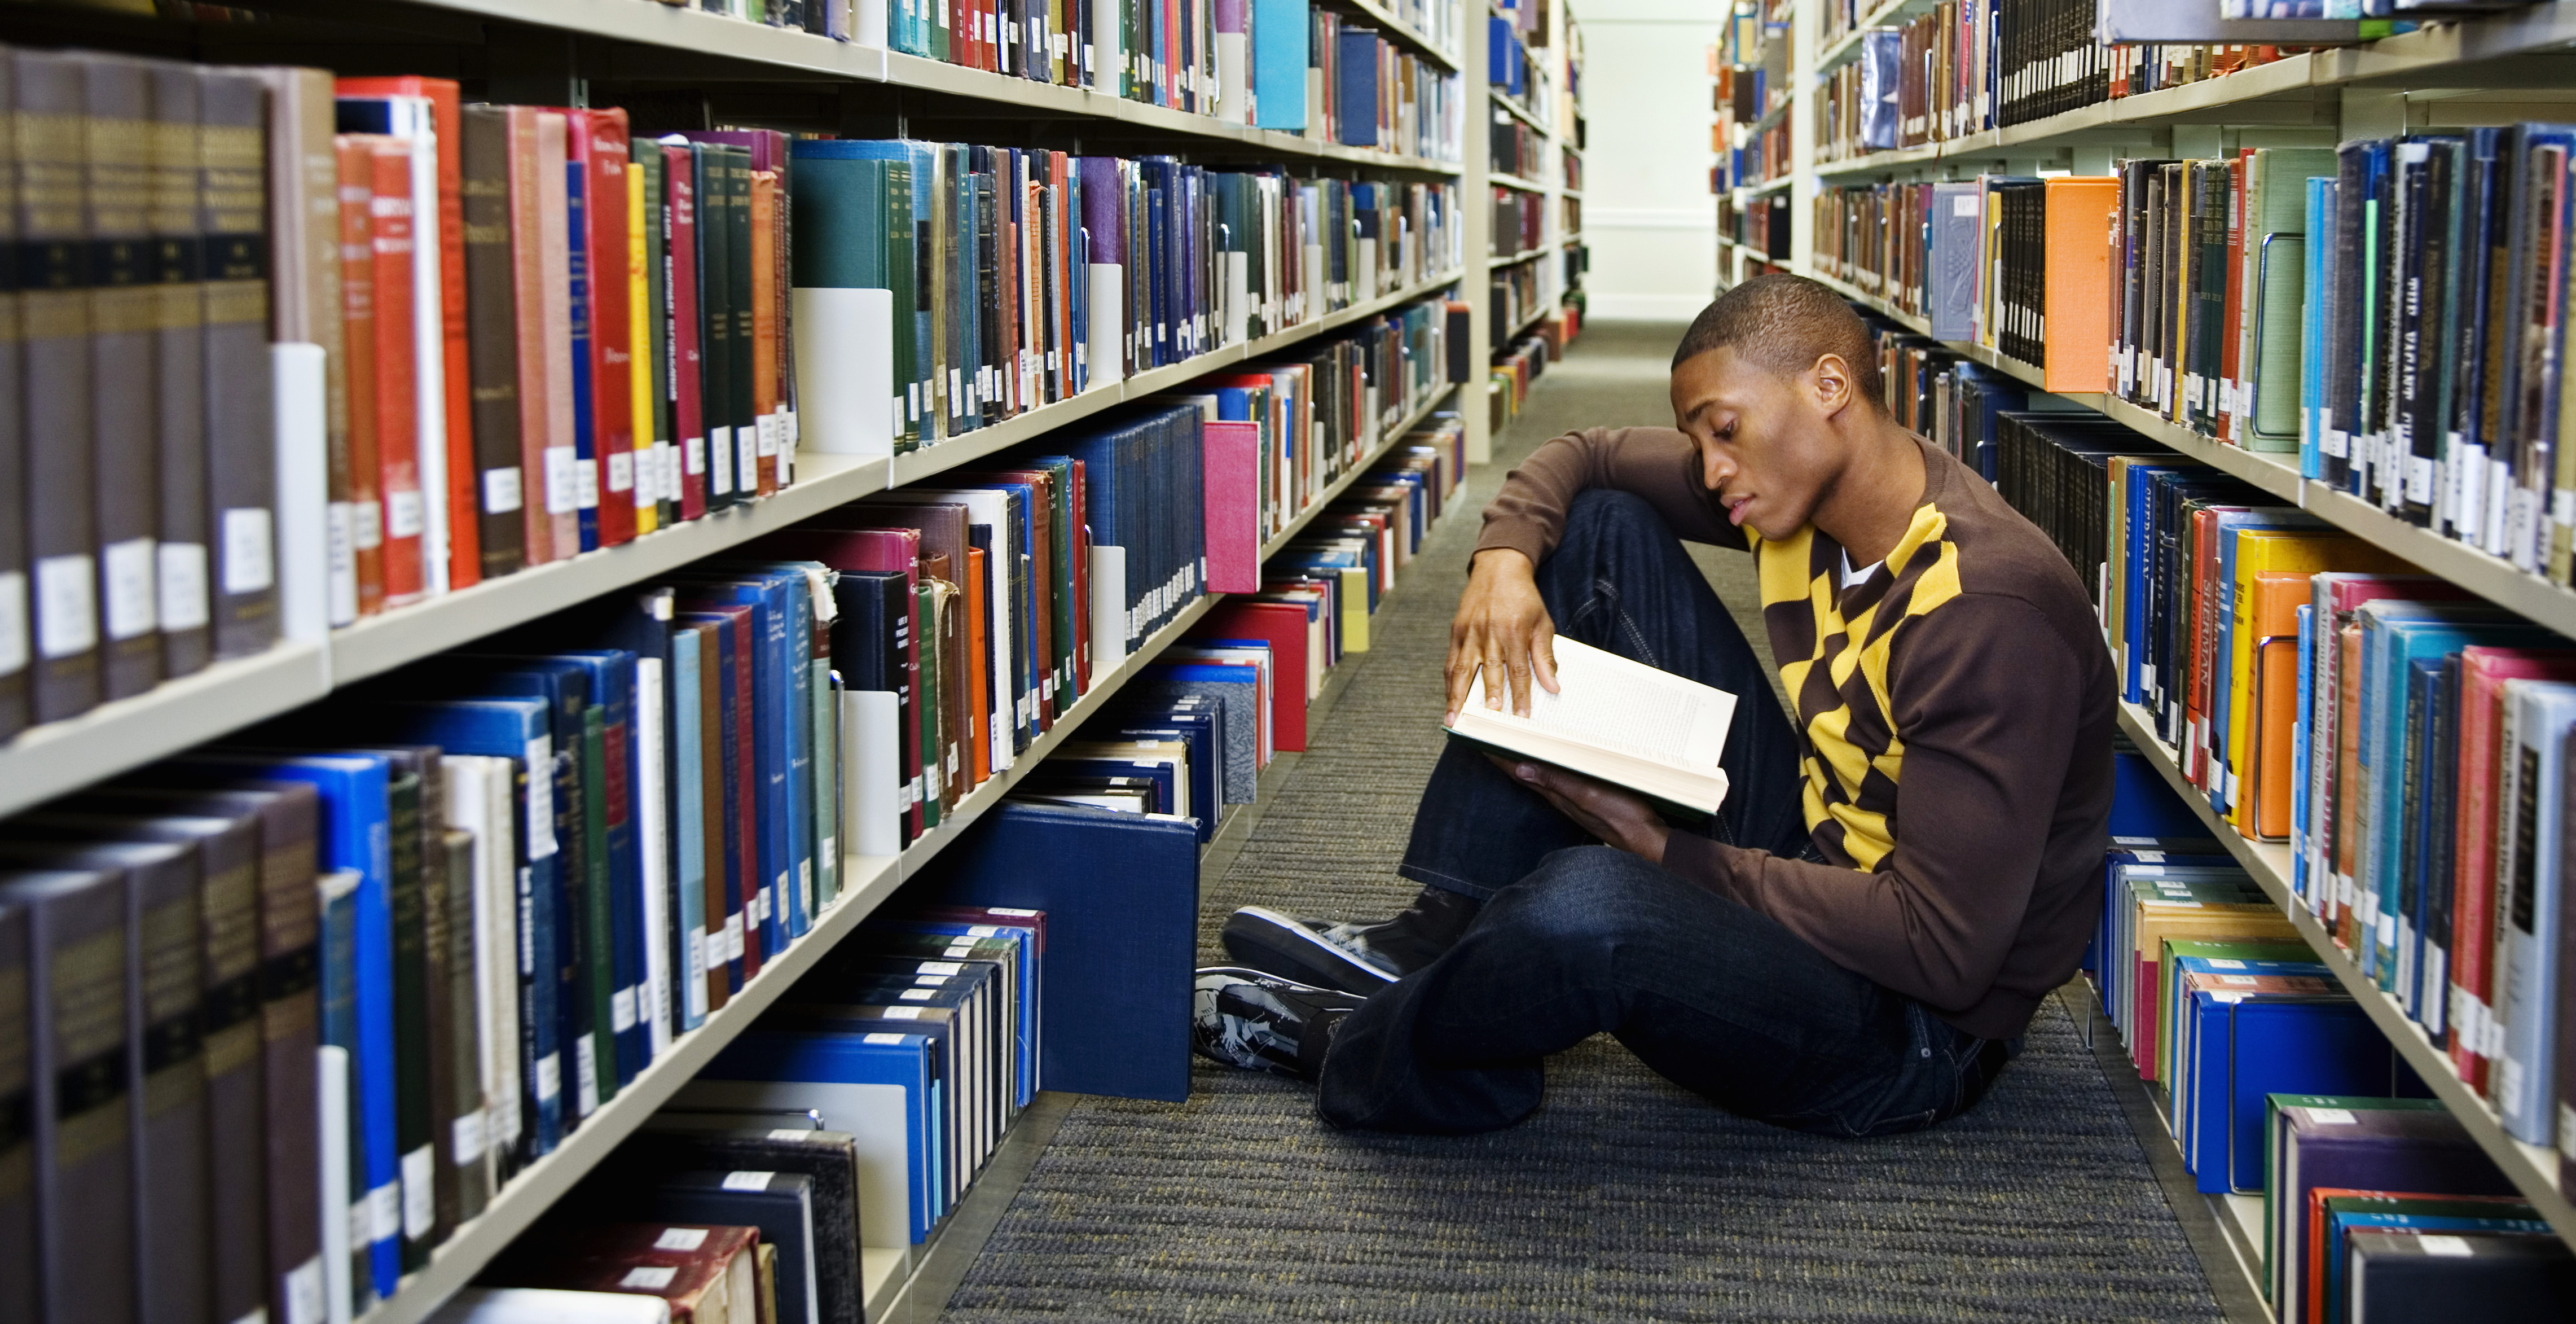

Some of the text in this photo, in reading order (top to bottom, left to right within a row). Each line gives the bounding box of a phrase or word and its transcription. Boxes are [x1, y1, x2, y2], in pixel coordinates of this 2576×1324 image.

[2407, 277, 2418, 316] THE
[2402, 331, 2416, 401] VACANT
[2143, 487, 2151, 579] SHERIDAN
[2200, 579, 2212, 686] SHERMAN
[2313, 606, 2328, 793] Missouri's Confederate
